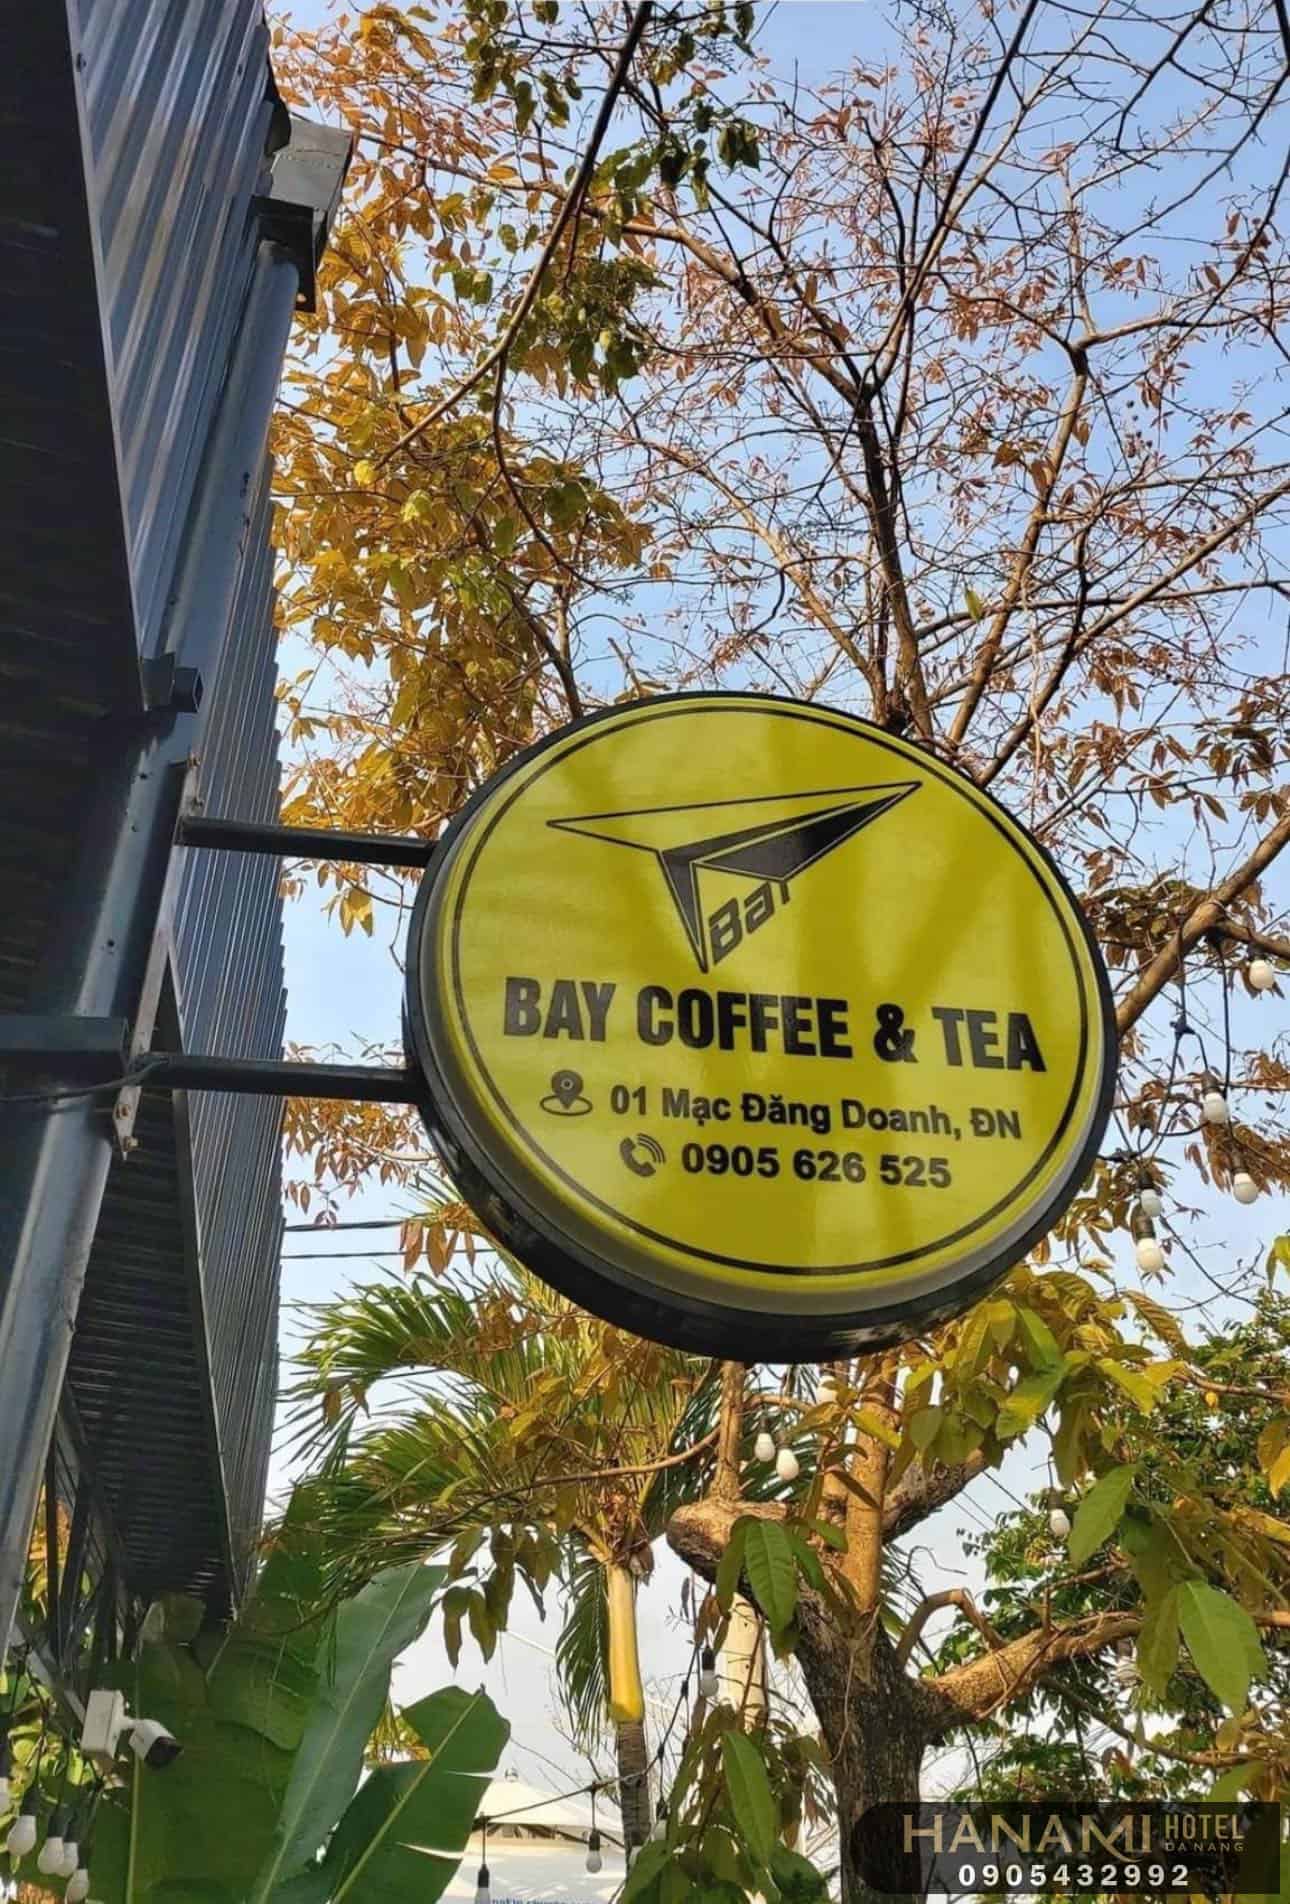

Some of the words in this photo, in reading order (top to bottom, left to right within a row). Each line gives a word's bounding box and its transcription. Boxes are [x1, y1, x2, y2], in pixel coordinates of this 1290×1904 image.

[503, 976, 617, 1042] BAY
[637, 985, 854, 1059] COFFEE
[873, 1003, 919, 1064] &
[931, 1006, 1048, 1073] TEA
[610, 1084, 648, 1116] 01
[662, 1087, 731, 1127] Mạc
[741, 1092, 832, 1134] Đăng
[842, 1099, 962, 1140] Doanh,
[970, 1108, 1022, 1140] ĐN
[681, 1142, 780, 1179] 0905
[793, 1149, 867, 1183] 626
[879, 1153, 952, 1188] 525
